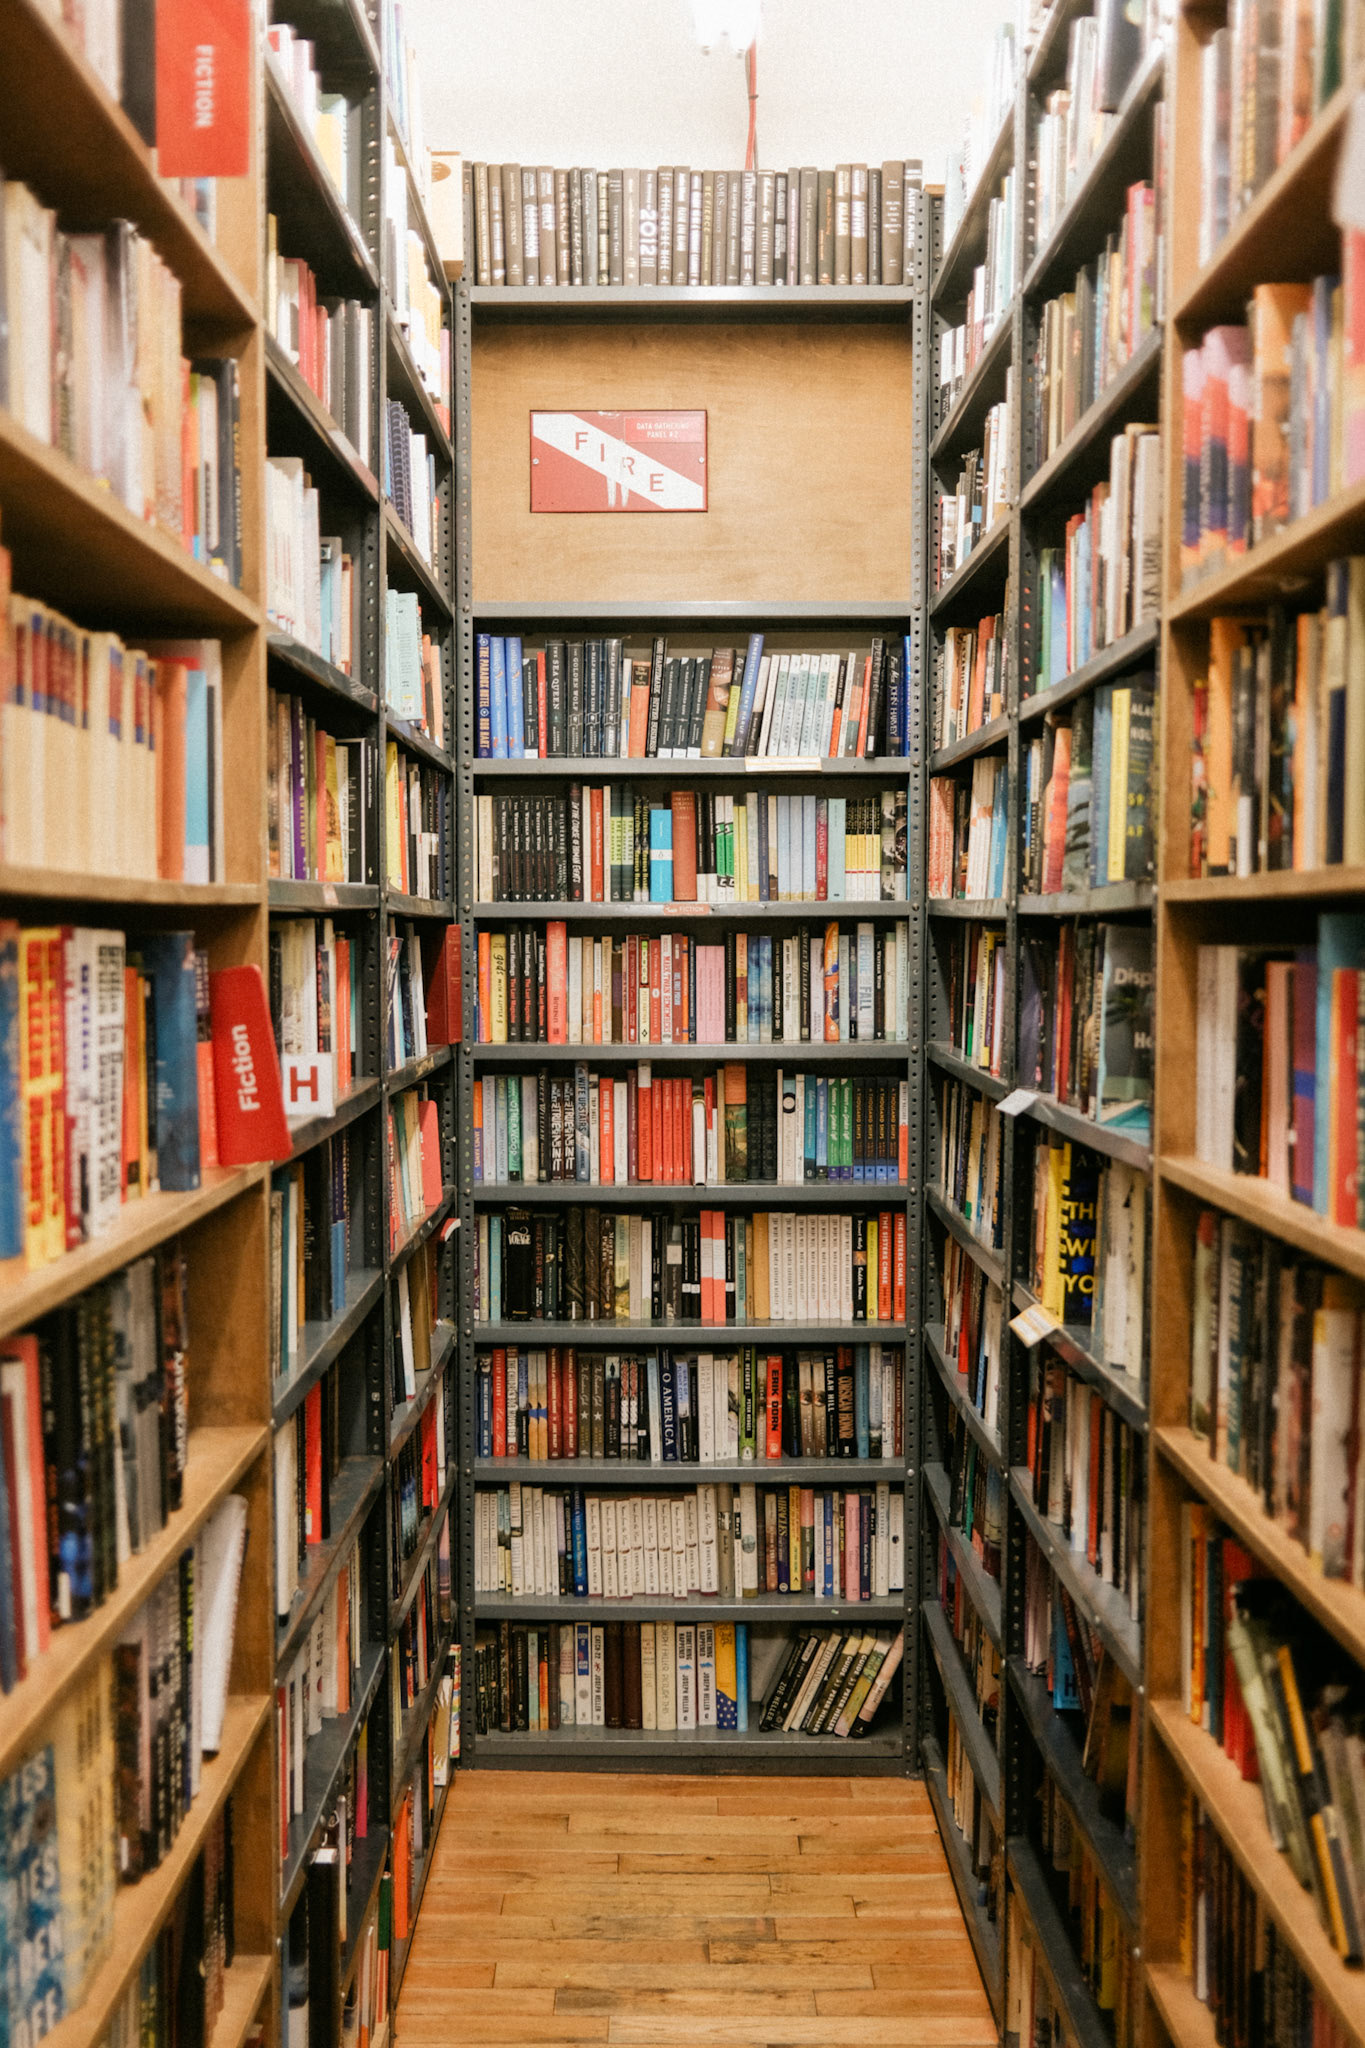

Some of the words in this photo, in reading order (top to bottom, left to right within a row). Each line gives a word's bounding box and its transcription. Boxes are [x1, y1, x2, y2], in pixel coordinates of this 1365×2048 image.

[194, 45, 214, 128] FICTION
[640, 209, 656, 256] 2012
[574, 431, 665, 492] FIRE
[479, 646, 490, 658] THE
[747, 637, 759, 685] BENEDICTION
[479, 659, 490, 687] PARADOX
[552, 659, 560, 676] SEA
[479, 689, 489, 708] HOTEL
[552, 678, 560, 710] QUEEN
[890, 685, 898, 705] JOHN
[651, 697, 660, 720] BITTER
[479, 717, 489, 729] ROB
[739, 711, 747, 734] HARUF
[889, 707, 897, 736] HARVEY
[479, 731, 489, 748] HART
[649, 721, 658, 752] BUSINESS
[494, 954, 504, 976] gods
[509, 956, 517, 976] Hastings
[859, 935, 871, 974] BEFORE
[663, 974, 672, 993] TWAIN
[859, 986, 872, 1011] FALL
[509, 999, 517, 1023] Magazine
[231, 1023, 261, 1112] Fiction
[289, 1065, 319, 1103] H
[538, 1074, 546, 1101] SWEET
[578, 1076, 586, 1095] WIFE
[578, 1097, 587, 1132] UPSTAIRS
[662, 1372, 672, 1383] O
[771, 1369, 779, 1396] ERIK
[826, 1358, 834, 1391] BEULAH
[838, 1376, 853, 1411] CORSICAN
[663, 1387, 674, 1446] AMERICA
[771, 1401, 779, 1432] DORN
[839, 1413, 854, 1439] HONOR
[778, 1496, 788, 1537] MIRACLES
[838, 1655, 853, 1676] GUIDE
[853, 1654, 868, 1674] GUIDE
[703, 1672, 711, 1692] JOSEPH
[775, 1681, 788, 1695] ZOË
[703, 1693, 711, 1711] HELLER
[765, 1696, 780, 1721] HELLER
[822, 1689, 838, 1709] PETER
[837, 1688, 854, 1708] PETER
[812, 1709, 828, 1733] HELLER
[826, 1708, 844, 1732] HELLER
